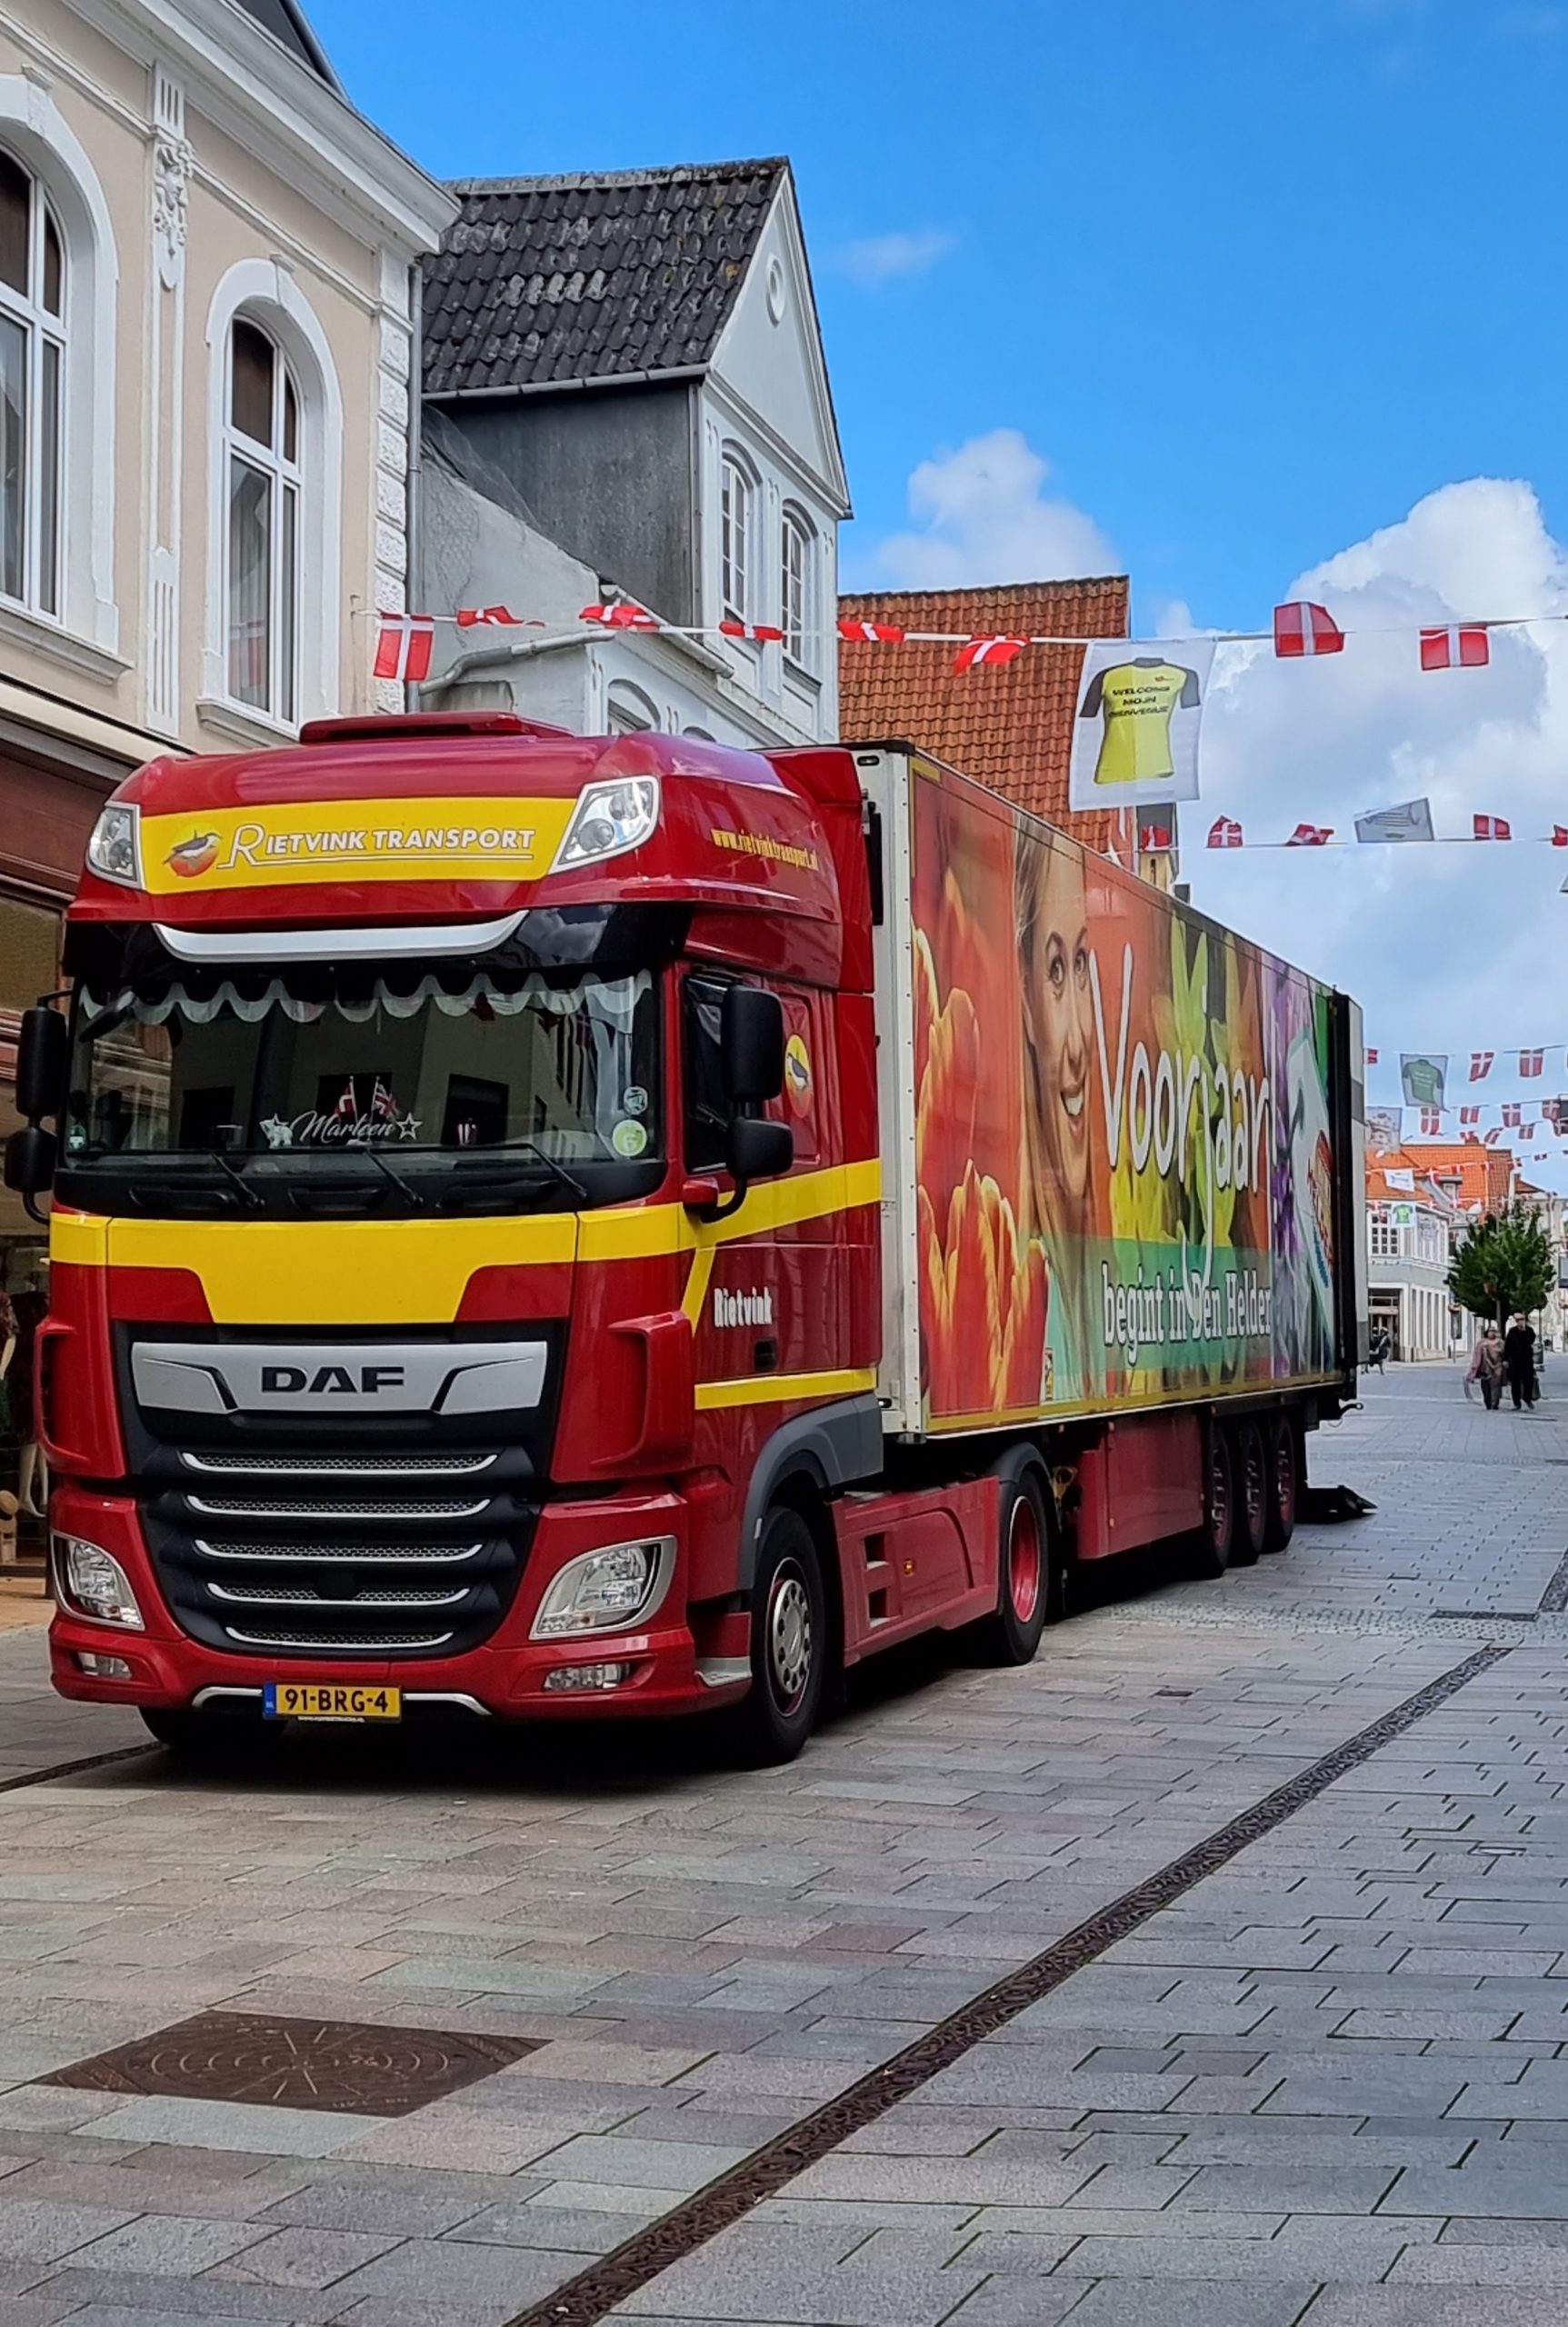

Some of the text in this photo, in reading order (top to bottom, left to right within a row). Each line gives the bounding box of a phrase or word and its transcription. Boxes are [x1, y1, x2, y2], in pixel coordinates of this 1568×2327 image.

[217, 824, 536, 869] RIETVINK TRANSPORT
[290, 1110, 396, 1144] Marleen
[714, 1286, 772, 1328] Rietvink
[1102, 1261, 1270, 1366] begint in Den Helder
[261, 1365, 405, 1393] DAF
[285, 1688, 389, 1713] 91-BRG-4
